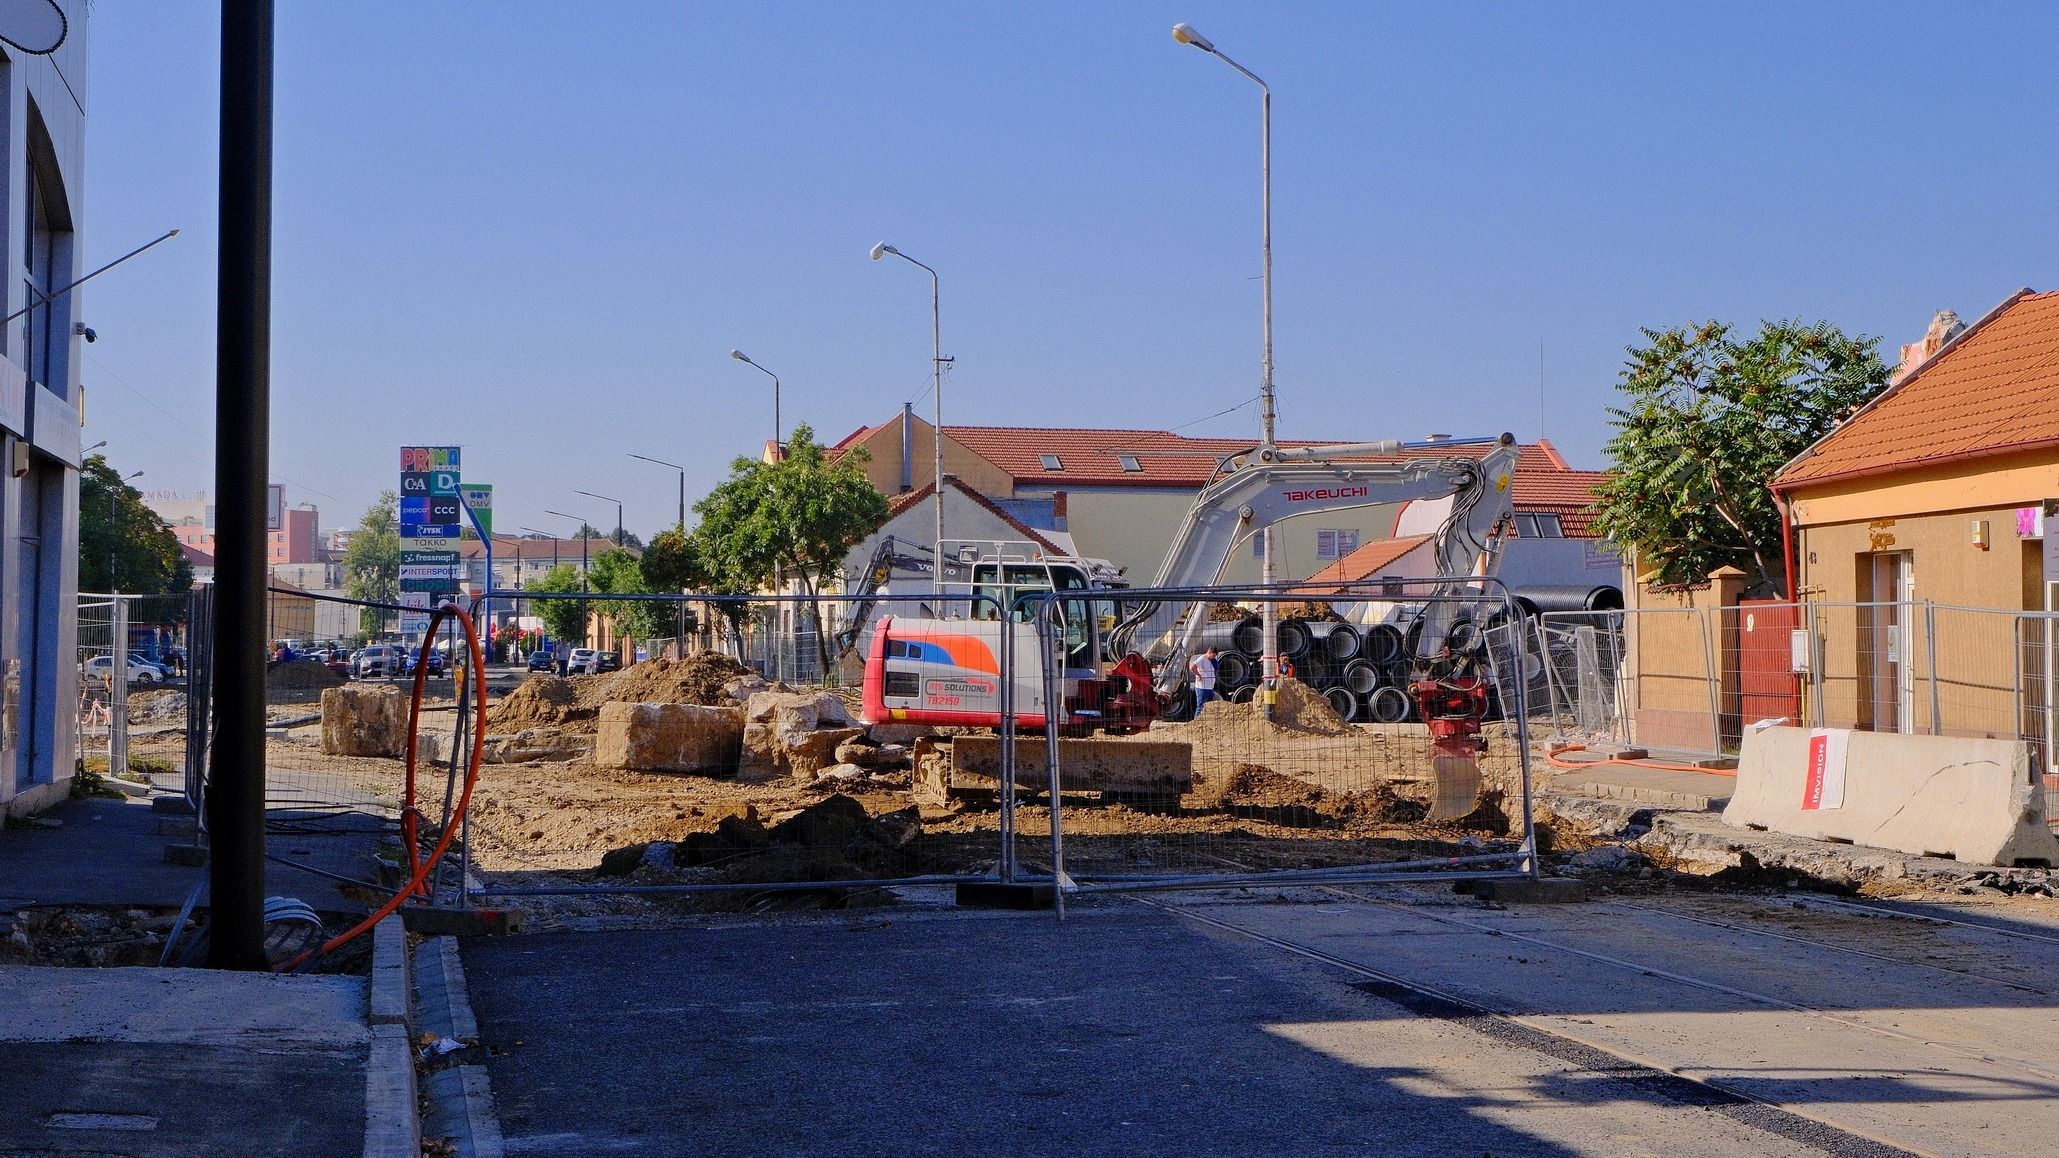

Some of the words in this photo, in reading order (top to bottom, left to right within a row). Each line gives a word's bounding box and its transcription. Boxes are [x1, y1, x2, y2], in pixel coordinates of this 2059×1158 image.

[404, 478, 427, 490] C&A
[470, 500, 490, 508] OMV
[403, 507, 427, 515] pepco
[434, 506, 456, 515] CCC
[415, 553, 456, 562] fressnapf
[944, 683, 988, 693] SOLUTIONS
[928, 696, 961, 706] TB2150
[1812, 744, 1825, 803] IMVISION
